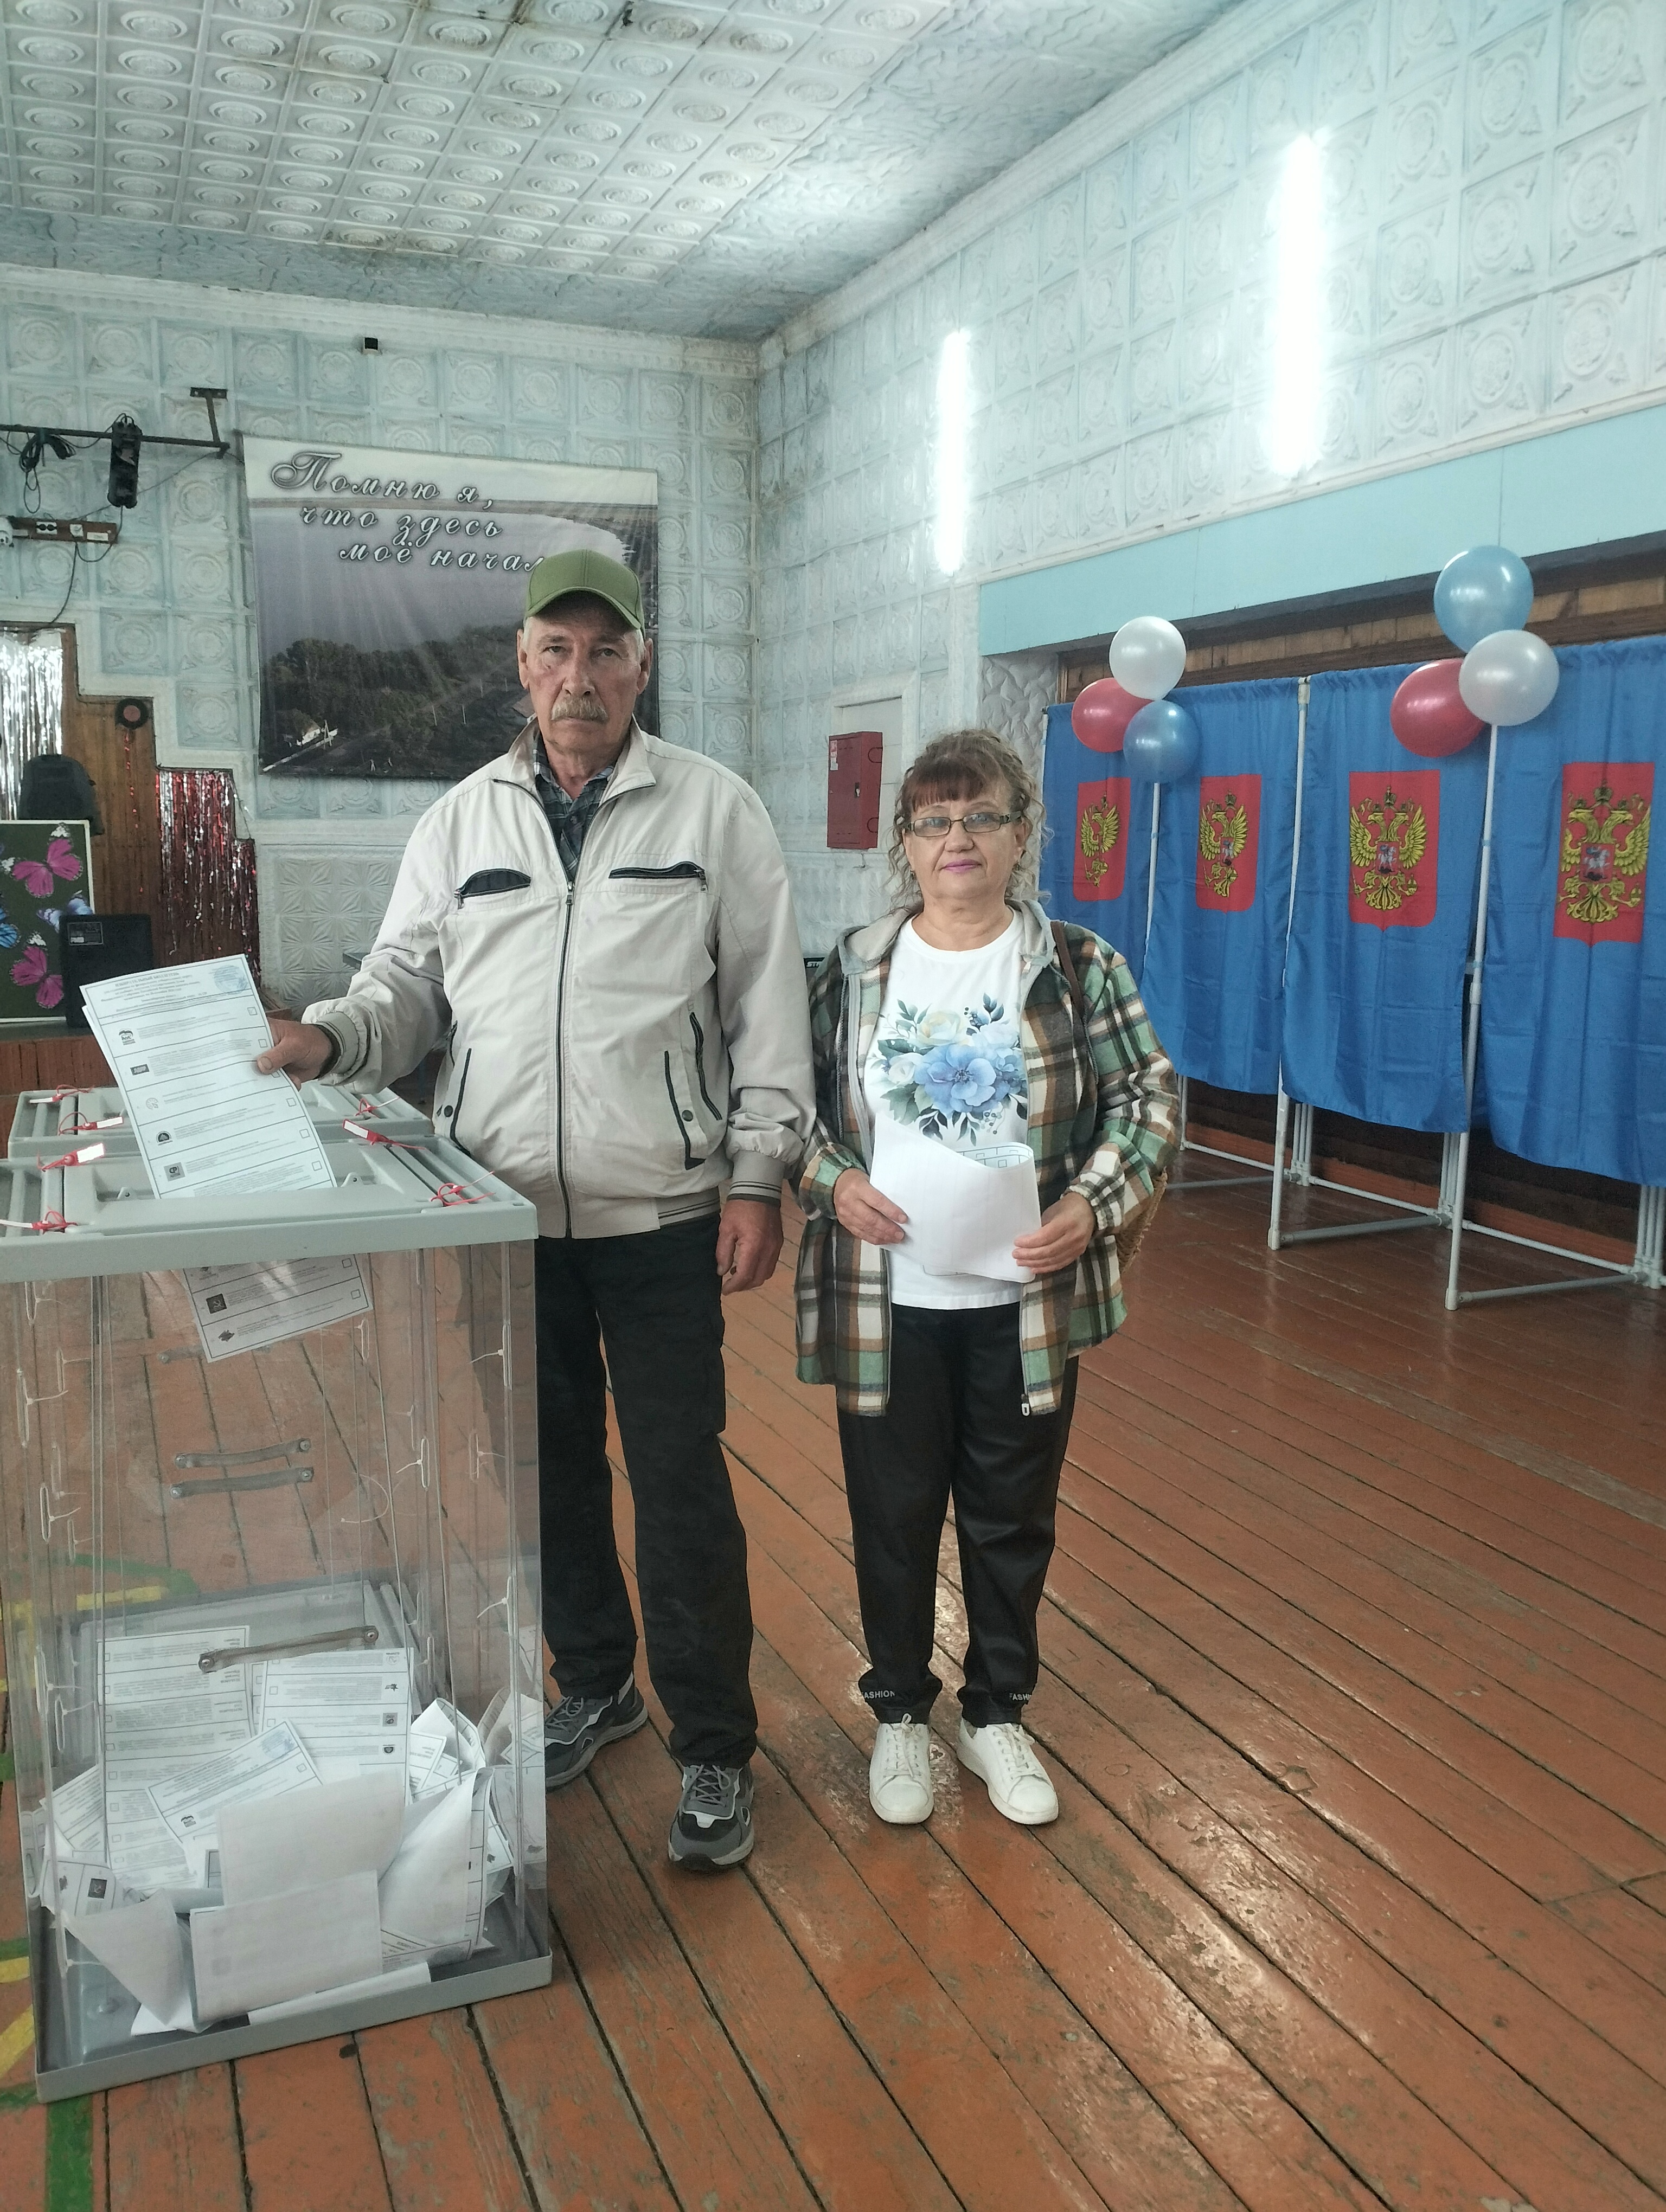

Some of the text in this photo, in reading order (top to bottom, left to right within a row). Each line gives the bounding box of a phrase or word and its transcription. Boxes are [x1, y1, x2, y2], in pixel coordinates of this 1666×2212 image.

[271, 451, 494, 511] Помню я,
[299, 505, 502, 548] что здесь
[339, 541, 544, 572] моё начал
[861, 1690, 895, 1699] ASHION
